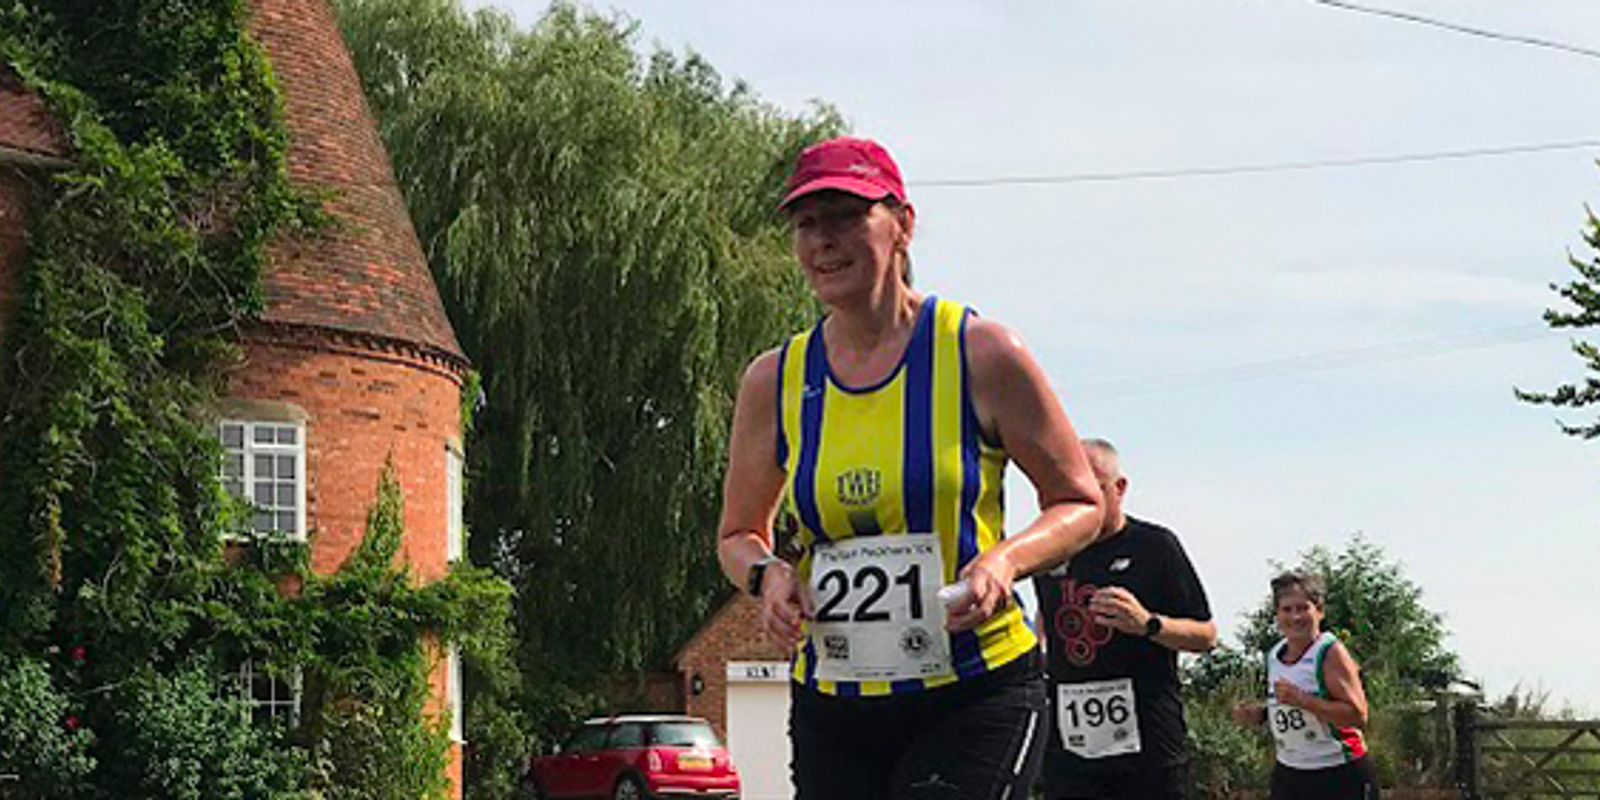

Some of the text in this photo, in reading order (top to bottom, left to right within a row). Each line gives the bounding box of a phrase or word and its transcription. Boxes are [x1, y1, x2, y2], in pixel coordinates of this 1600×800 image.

[817, 564, 924, 622] 221
[1065, 695, 1129, 728] 196
[1274, 708, 1306, 733] 98
